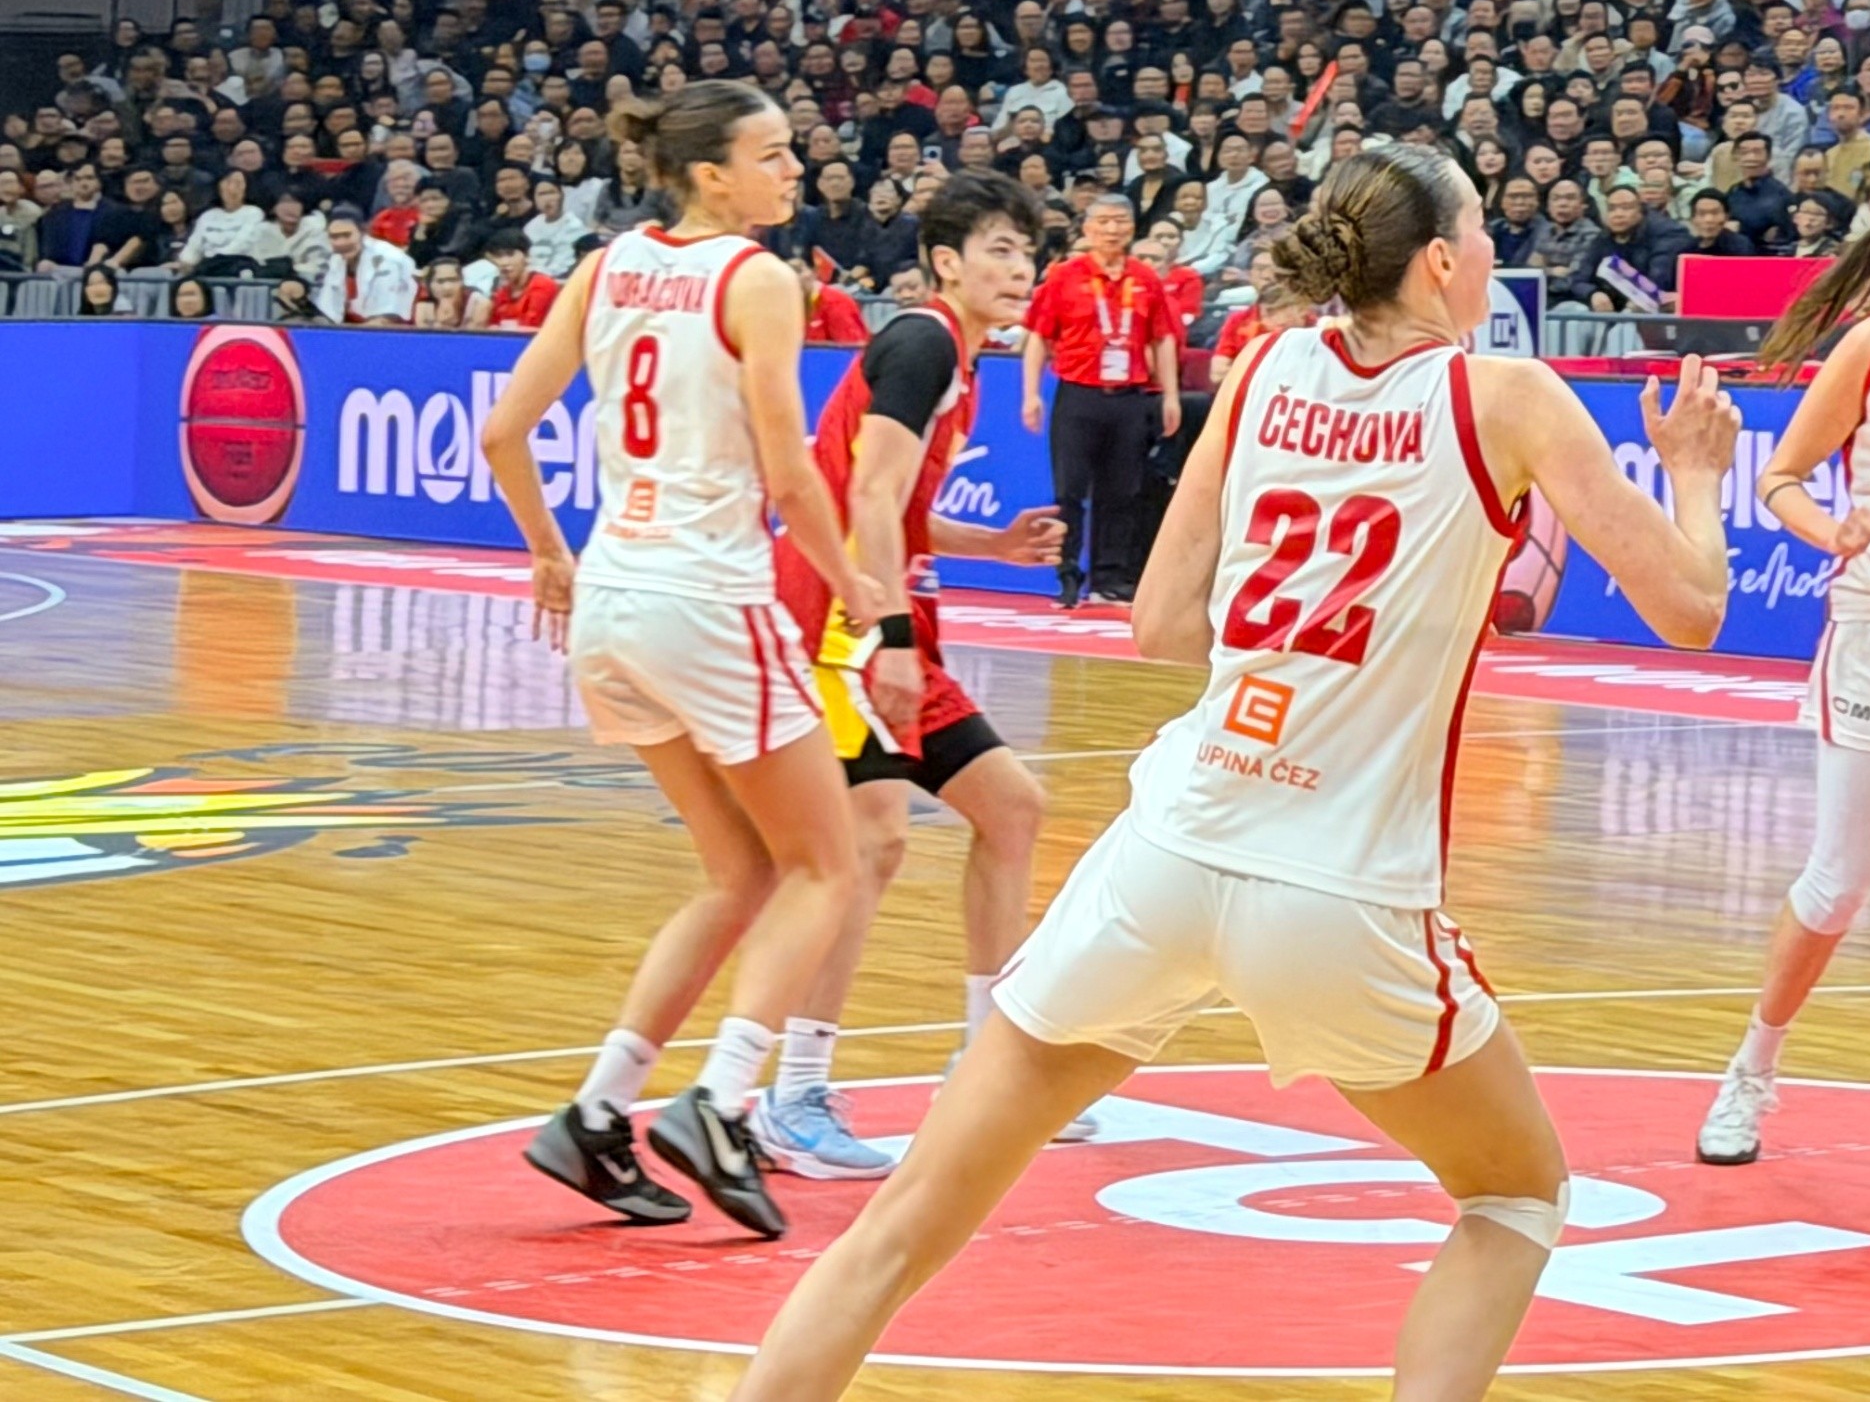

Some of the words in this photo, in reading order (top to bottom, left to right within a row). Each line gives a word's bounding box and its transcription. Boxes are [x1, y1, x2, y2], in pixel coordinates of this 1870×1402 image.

[623, 335, 663, 459] 8
[1258, 384, 1425, 464] ČECHOVÁ
[1221, 488, 1402, 666] 22
[1269, 757, 1321, 791] ČEZ
